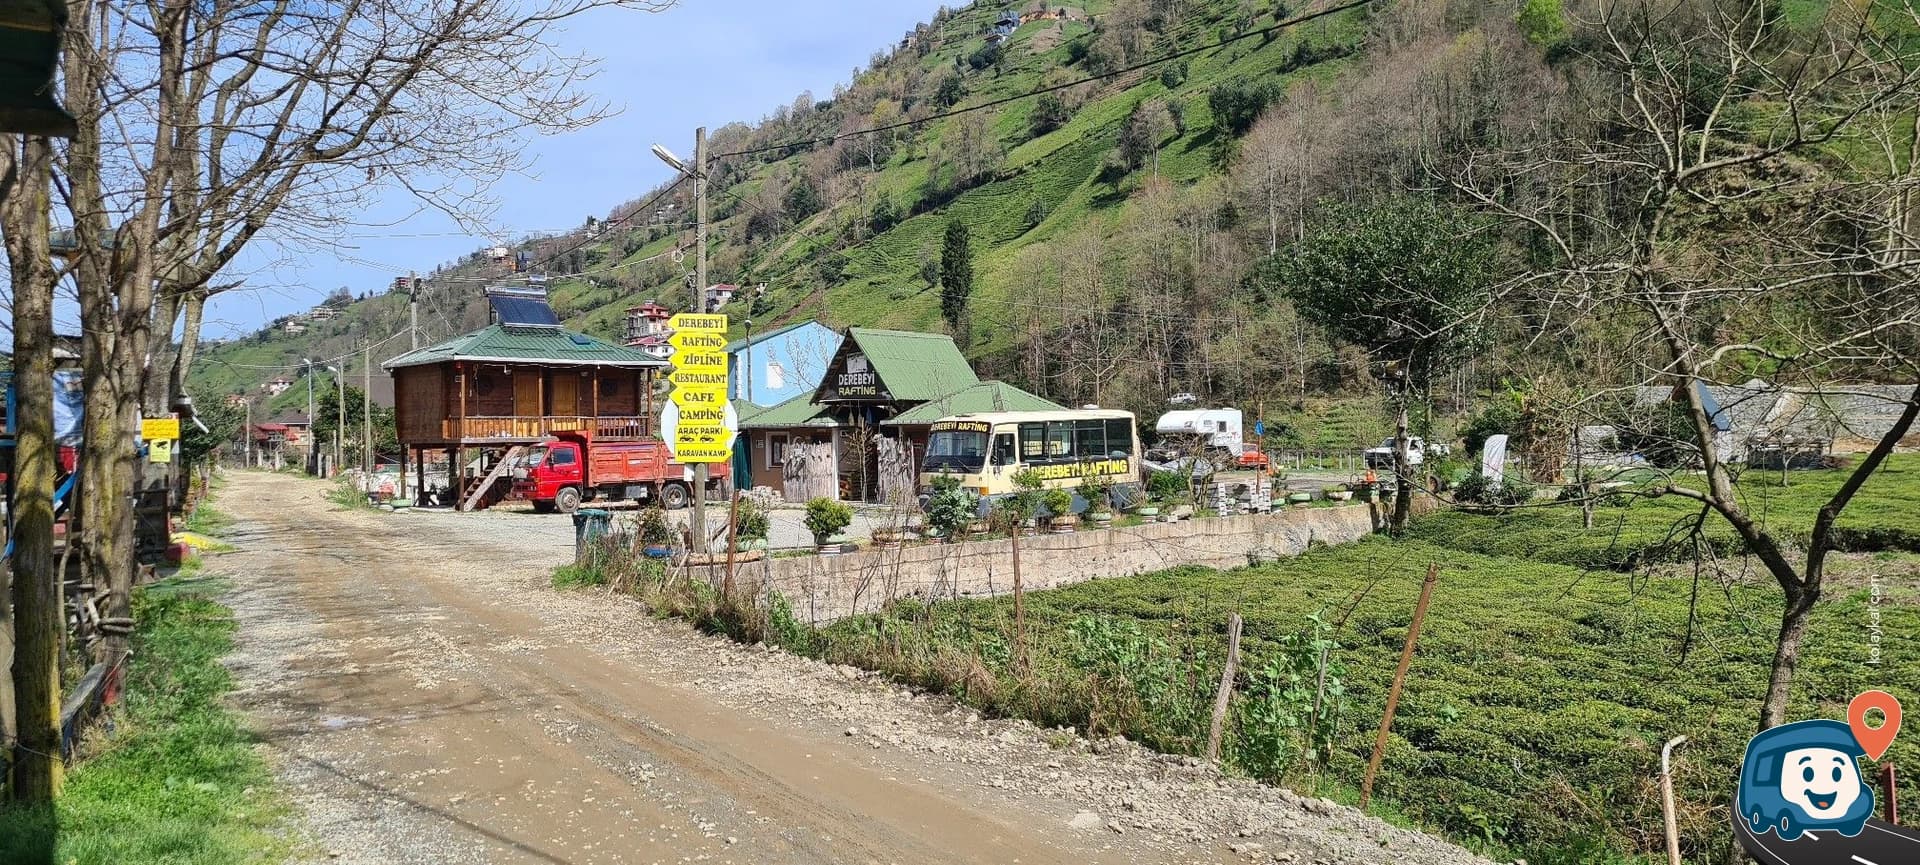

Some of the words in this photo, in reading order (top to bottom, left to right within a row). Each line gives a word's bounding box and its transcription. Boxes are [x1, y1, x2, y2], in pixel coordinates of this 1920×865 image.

[678, 316, 723, 329] DEREBEYİ
[681, 335, 722, 347] RAFTİNG
[683, 353, 723, 366] ZİPLİNE
[674, 373, 726, 384] RESTAURANT
[838, 370, 875, 386] DEREBEYİ
[838, 385, 876, 396] RAFTİNG
[683, 392, 715, 403] CAFE
[679, 408, 724, 420] CAMPİNG
[678, 427, 699, 437] ARAÇ
[700, 427, 723, 435] PARKI
[677, 449, 708, 457] KARAVAN
[708, 449, 727, 457] KAMP
